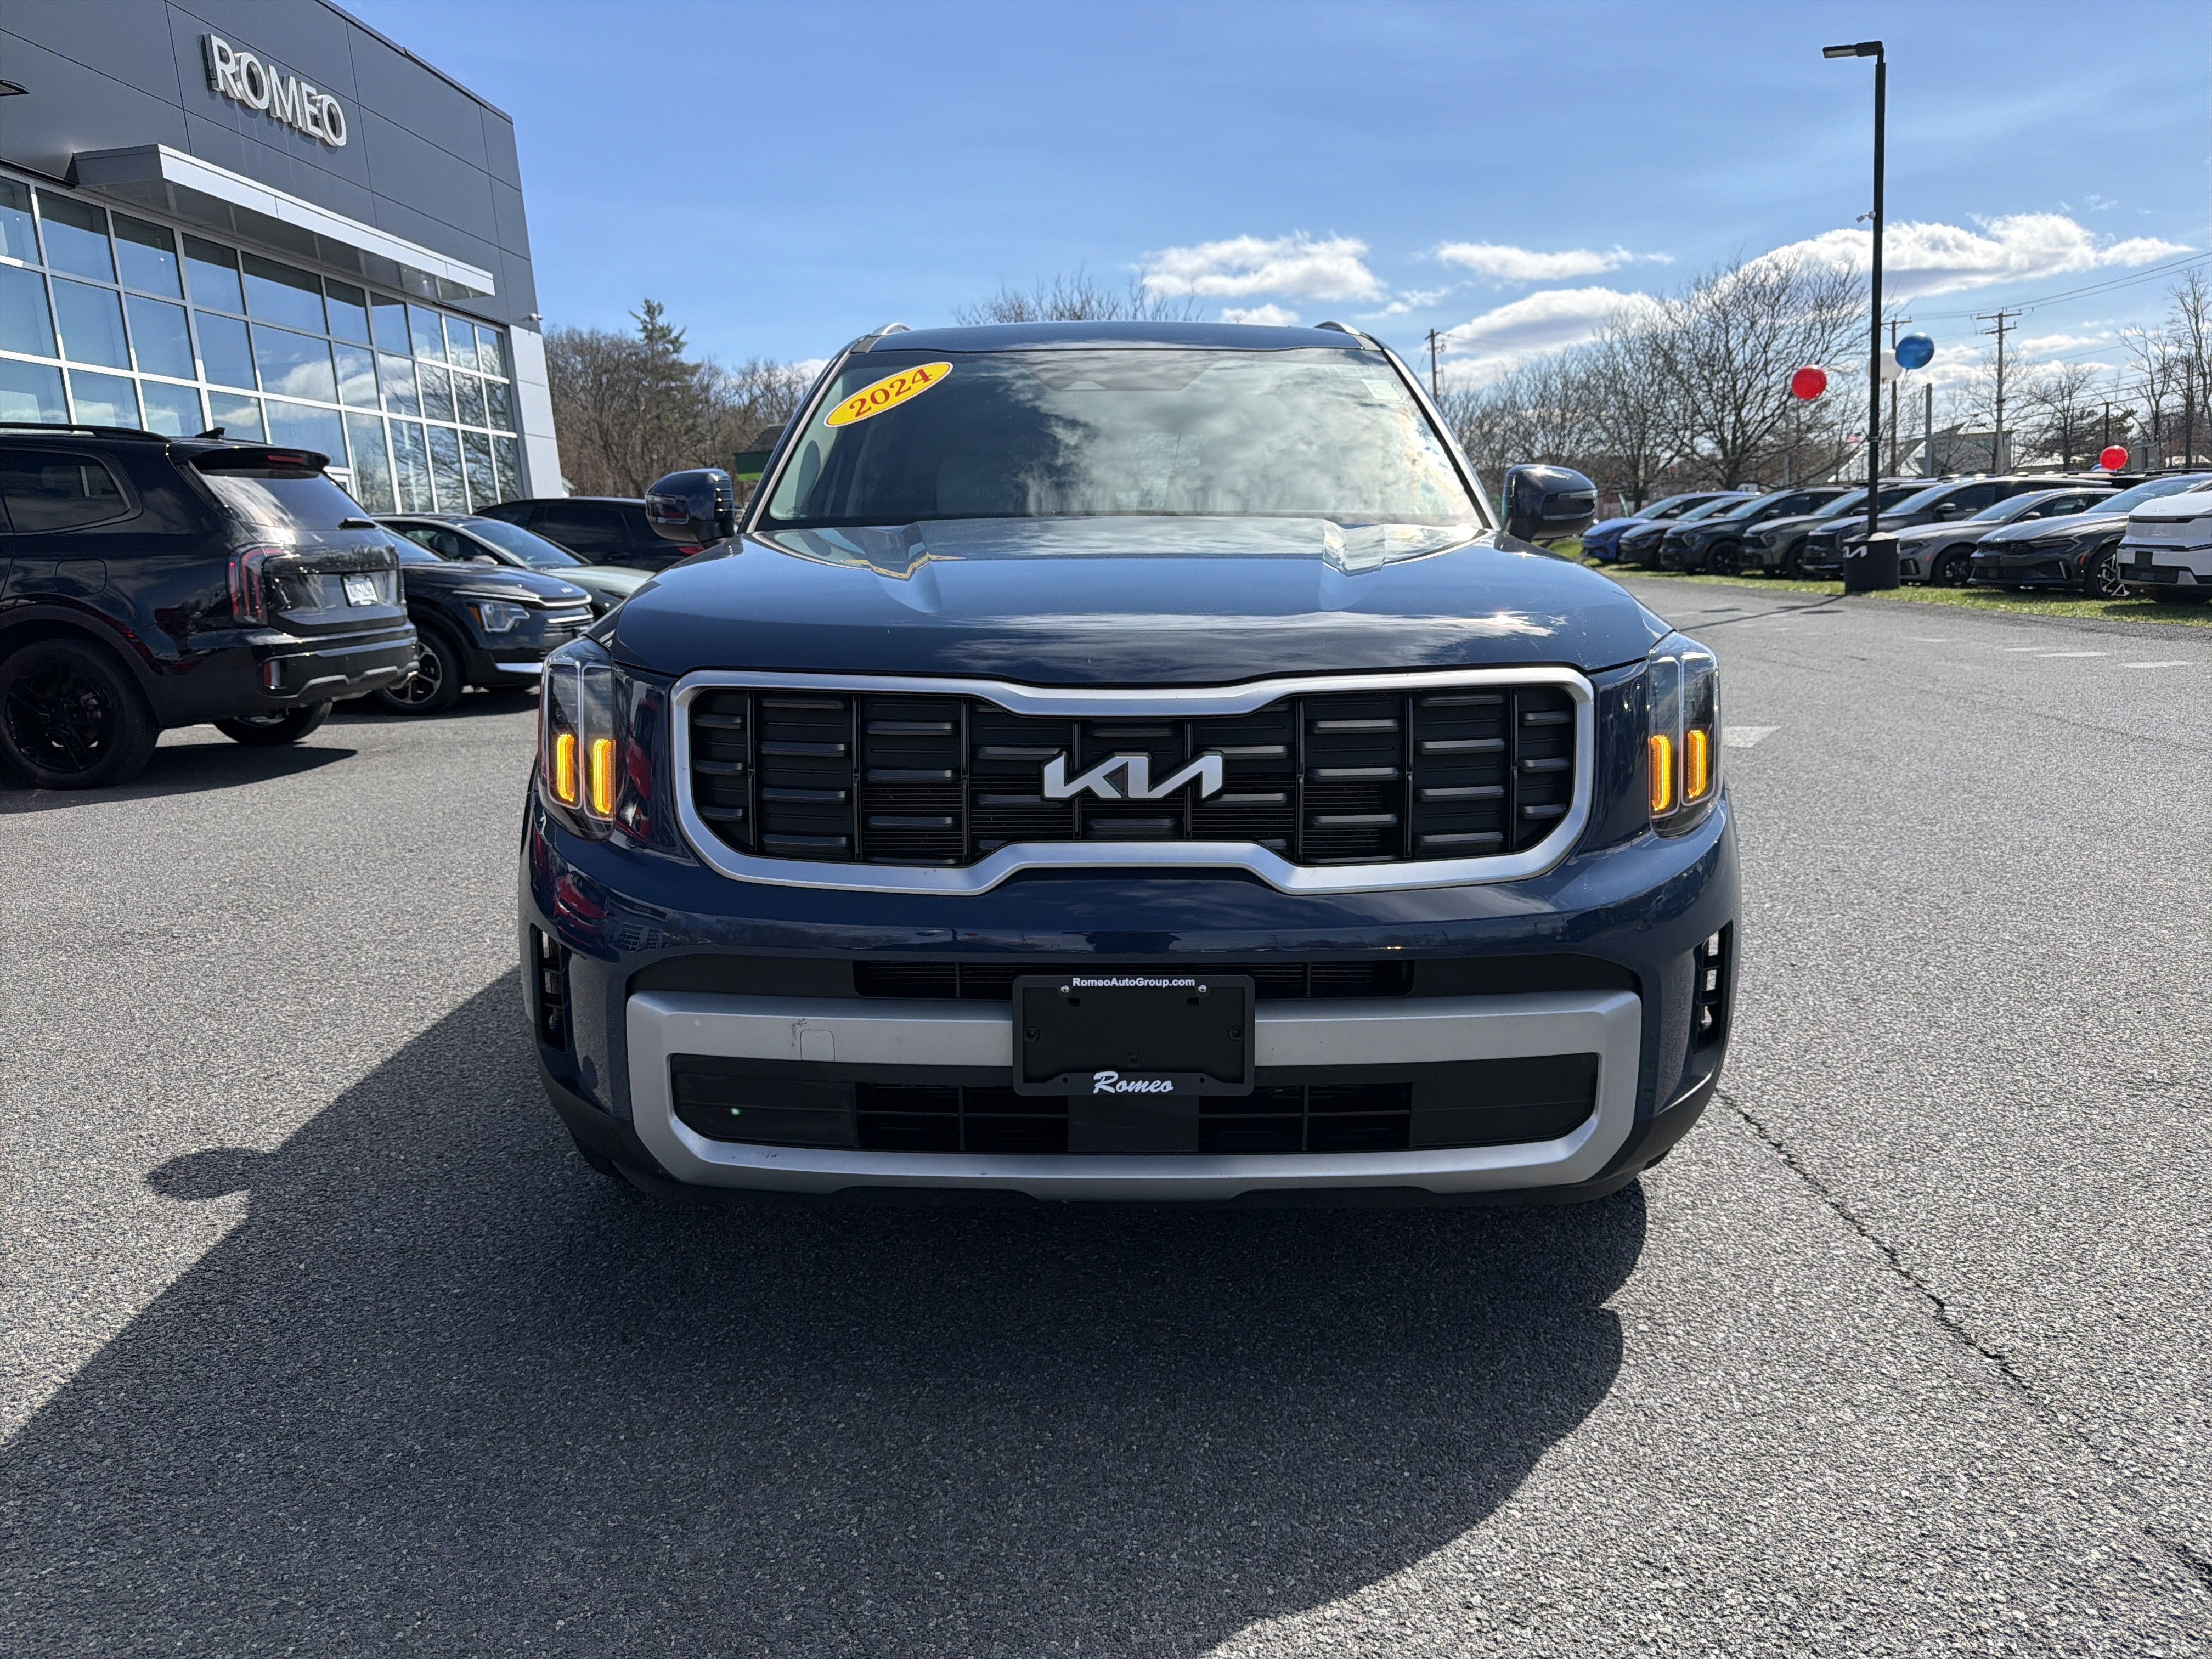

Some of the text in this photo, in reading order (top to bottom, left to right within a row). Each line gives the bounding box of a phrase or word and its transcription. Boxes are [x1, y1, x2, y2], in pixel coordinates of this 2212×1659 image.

[202, 33, 347, 146] ROMEO
[849, 369, 933, 417] 2024
[1043, 754, 1223, 799] KIA
[1073, 977, 1195, 988] RomeoAutoGroup.com
[1093, 1071, 1174, 1094] Romeo
